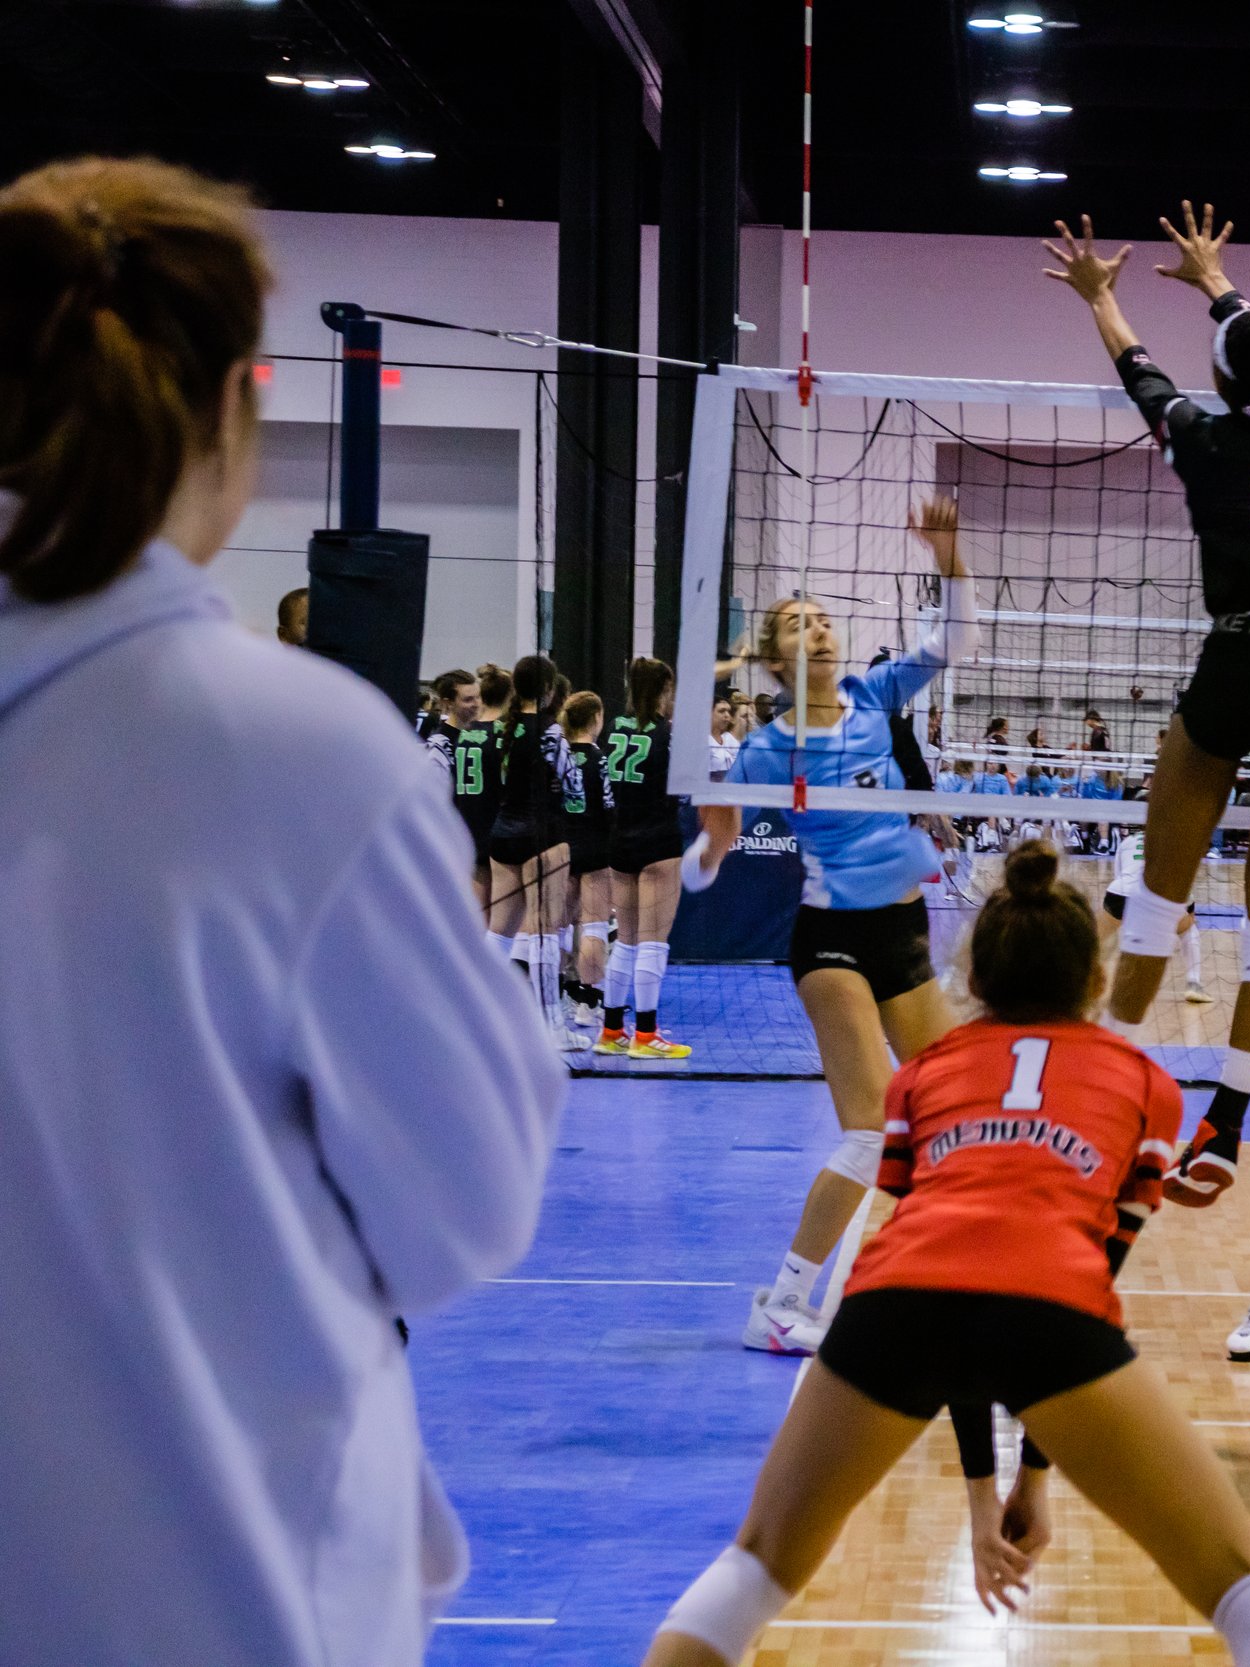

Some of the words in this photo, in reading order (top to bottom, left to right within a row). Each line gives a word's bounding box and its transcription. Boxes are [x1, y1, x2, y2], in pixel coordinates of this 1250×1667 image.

[455, 747, 484, 795] 13
[607, 733, 652, 784] 22
[1002, 1037, 1051, 1111] 1
